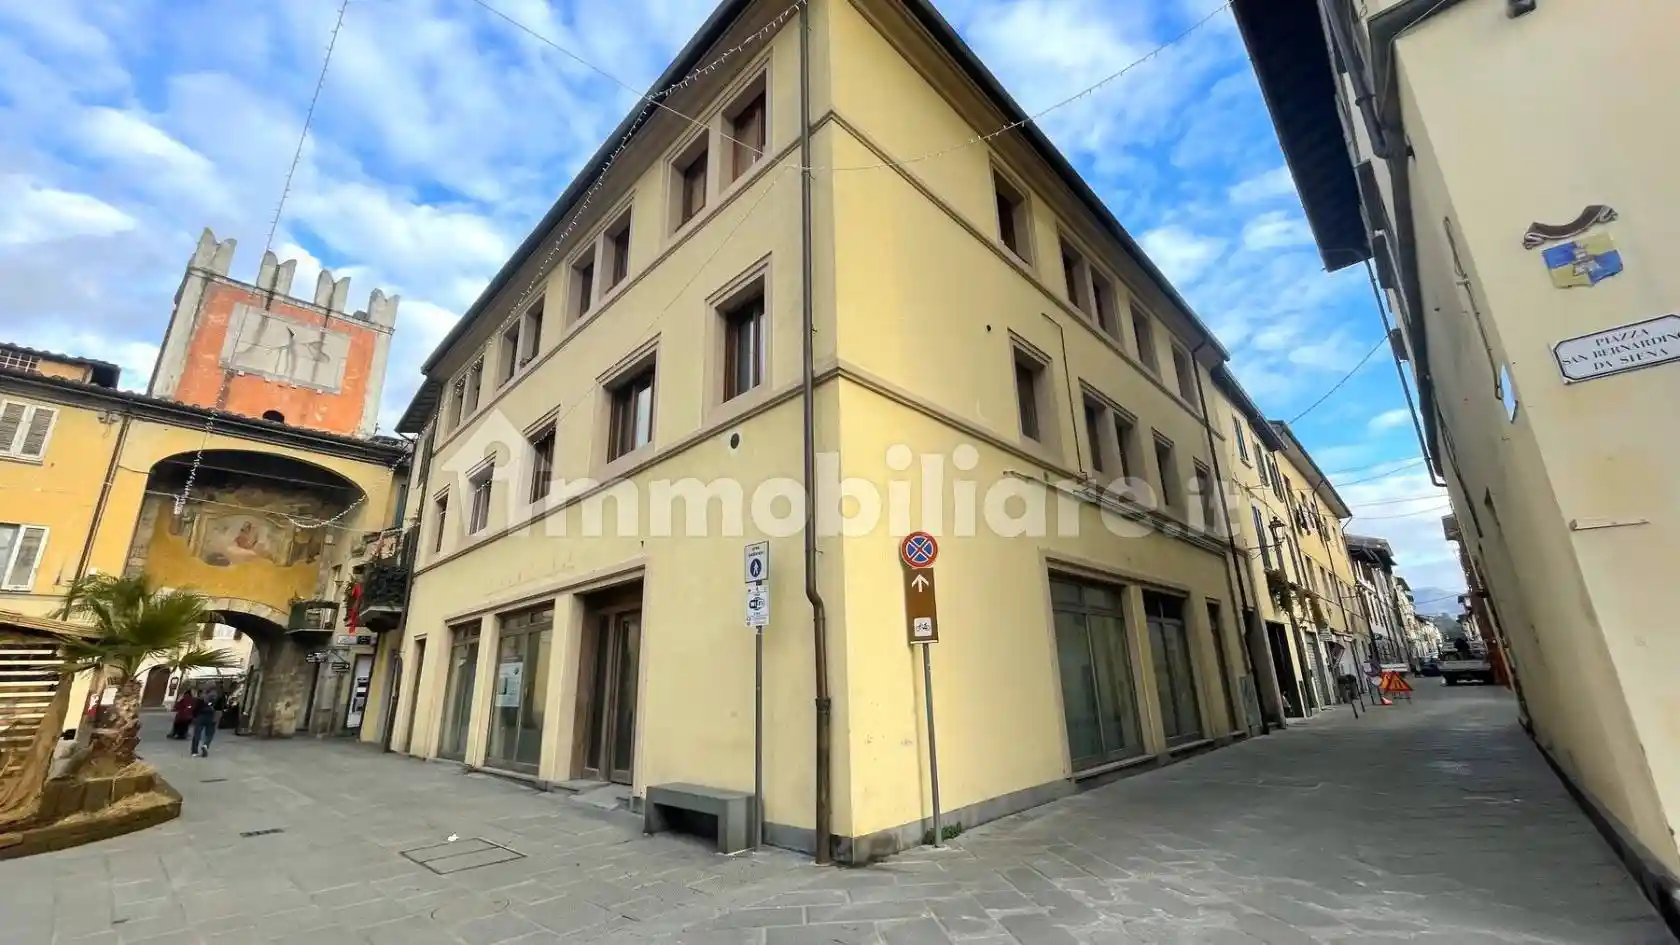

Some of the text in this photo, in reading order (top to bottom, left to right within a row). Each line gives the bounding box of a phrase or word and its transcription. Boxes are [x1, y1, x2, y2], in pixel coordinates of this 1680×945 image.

[1594, 328, 1649, 347] PIAZZA
[1561, 353, 1589, 367] SAN
[1592, 347, 1669, 371] DA SIENA
